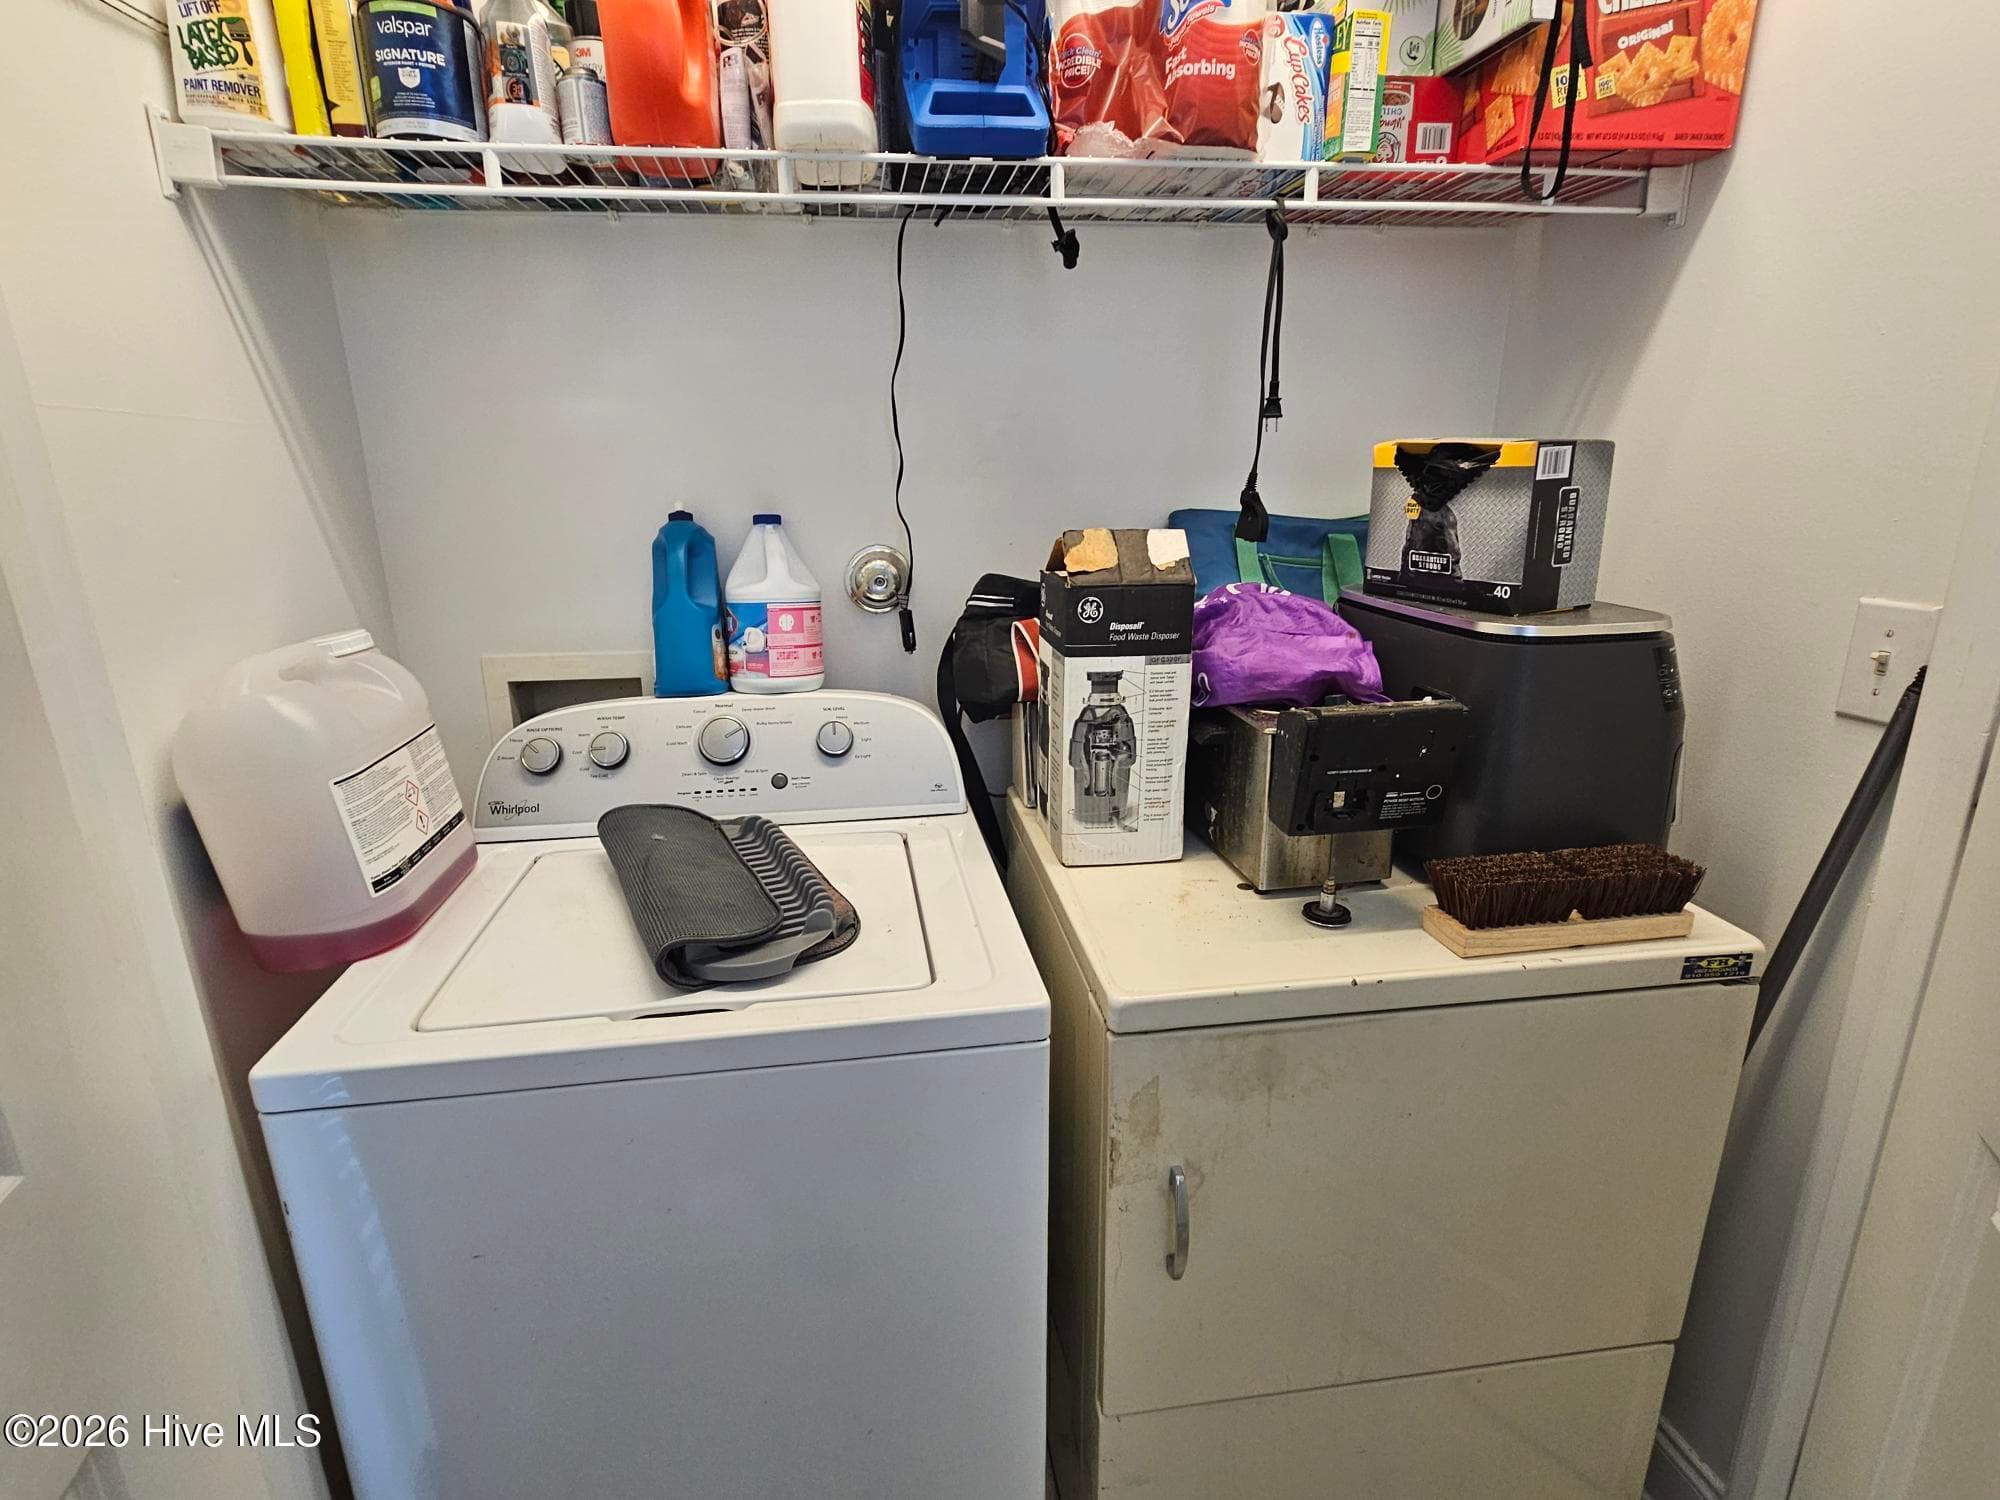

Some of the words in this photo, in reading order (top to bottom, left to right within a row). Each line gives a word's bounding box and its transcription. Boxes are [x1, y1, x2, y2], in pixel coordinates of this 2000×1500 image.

[178, 1, 200, 18] LIFT
[200, 0, 221, 14] OFF
[176, 17, 232, 49] LATEX
[376, 15, 433, 38] valspar
[575, 48, 592, 58] 3M
[1314, 26, 1326, 66] Hostess
[187, 43, 239, 71] BASED
[375, 48, 446, 67] SIGNATURE
[1165, 46, 1188, 74] Fast
[1164, 58, 1236, 90] Absorbing
[1283, 35, 1314, 124] CupCakes
[184, 78, 208, 91] PAINT
[211, 79, 262, 99] REMOVER
[1382, 108, 1402, 116] CHIL
[1562, 492, 1577, 559] GUARANTEED
[1493, 586, 1511, 600] 40
[1110, 622, 1143, 632] Disposall
[1110, 632, 1126, 640] Food
[1128, 632, 1150, 640] Waste
[1150, 632, 1180, 641] Disposer
[490, 803, 540, 816] Whirlpool
